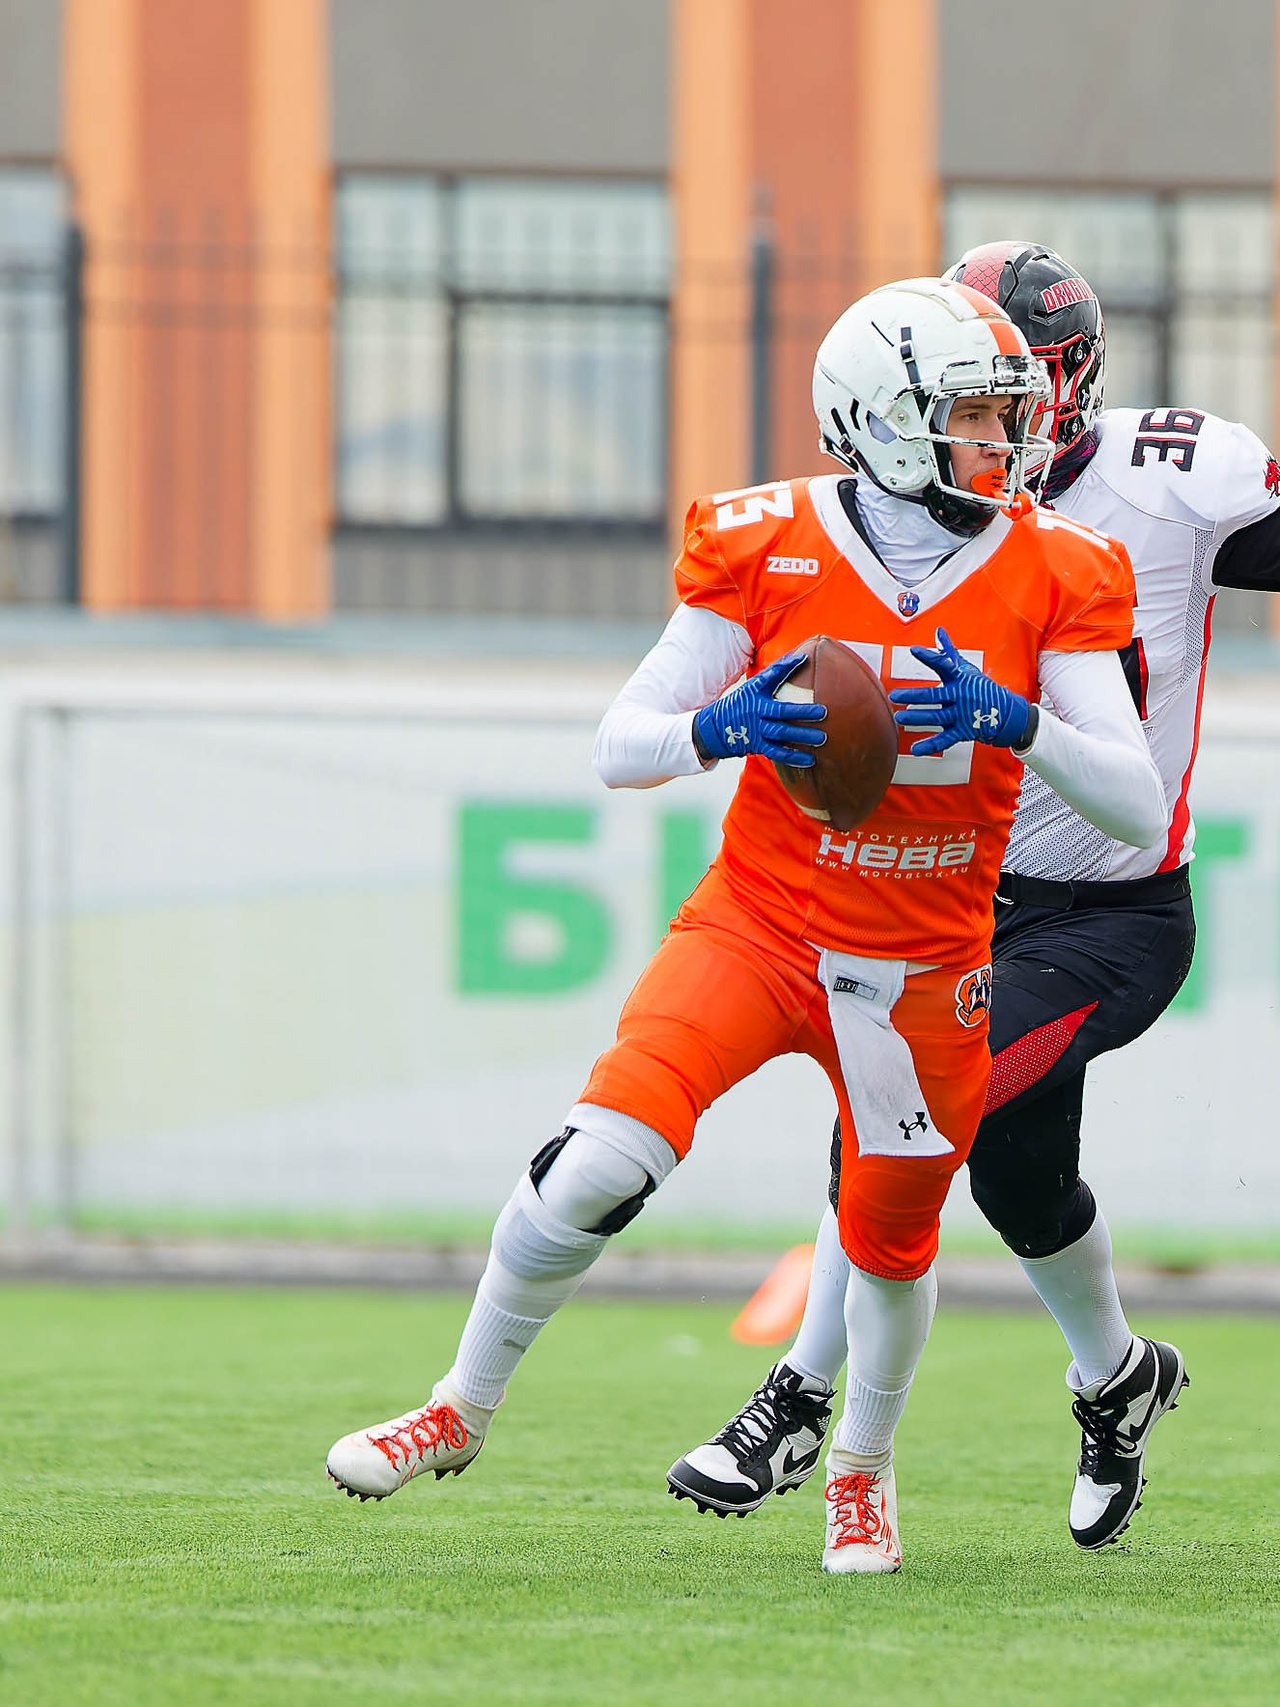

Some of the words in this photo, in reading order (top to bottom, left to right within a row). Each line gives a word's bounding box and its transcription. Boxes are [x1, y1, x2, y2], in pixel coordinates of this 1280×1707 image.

[1131, 409, 1205, 473] 36
[712, 480, 794, 530] 13
[767, 556, 819, 575] ZEDO
[824, 826, 977, 844] ТОТЕХНИКА
